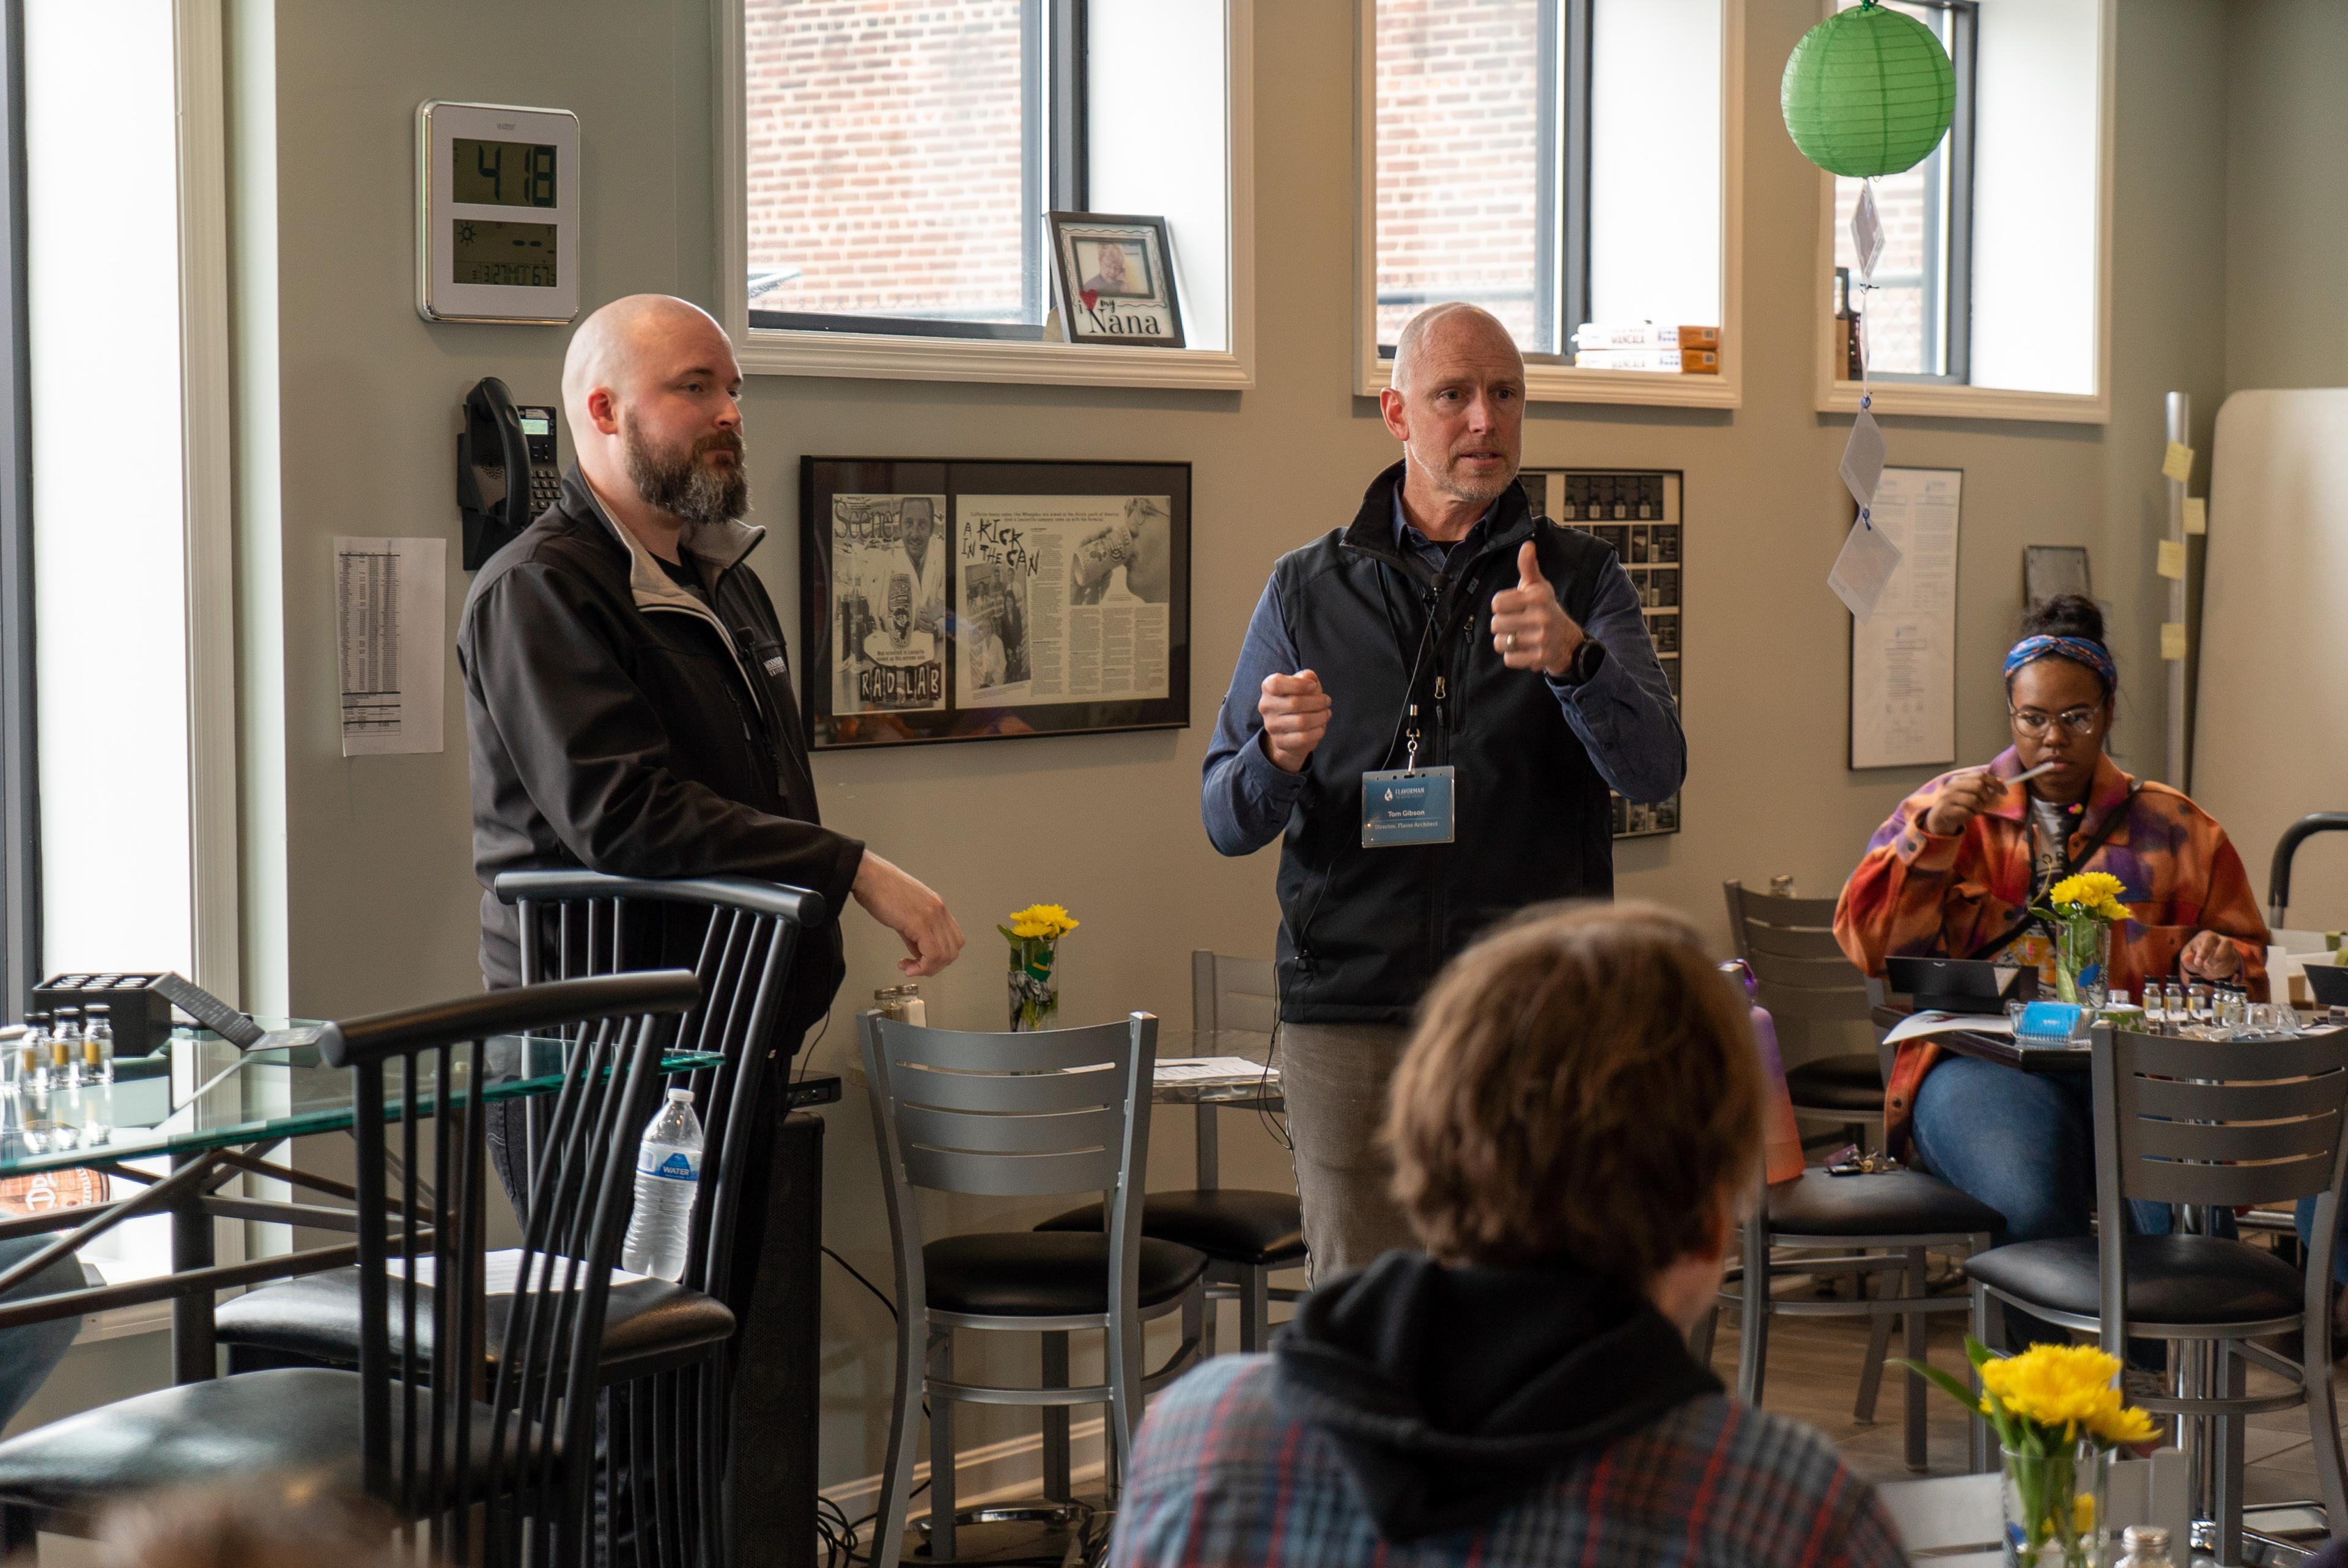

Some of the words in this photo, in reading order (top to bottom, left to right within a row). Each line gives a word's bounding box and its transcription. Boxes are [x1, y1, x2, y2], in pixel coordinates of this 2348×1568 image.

[1087, 308, 1160, 334] Nana
[834, 499, 894, 539] Scene
[964, 522, 972, 538] A
[977, 518, 1024, 552] KICK
[962, 538, 976, 559] IN
[980, 544, 1002, 565] THE
[1006, 547, 1039, 576] CAN
[862, 668, 895, 698] RAD
[906, 666, 939, 695] LAB
[663, 1166, 690, 1176] WATER
